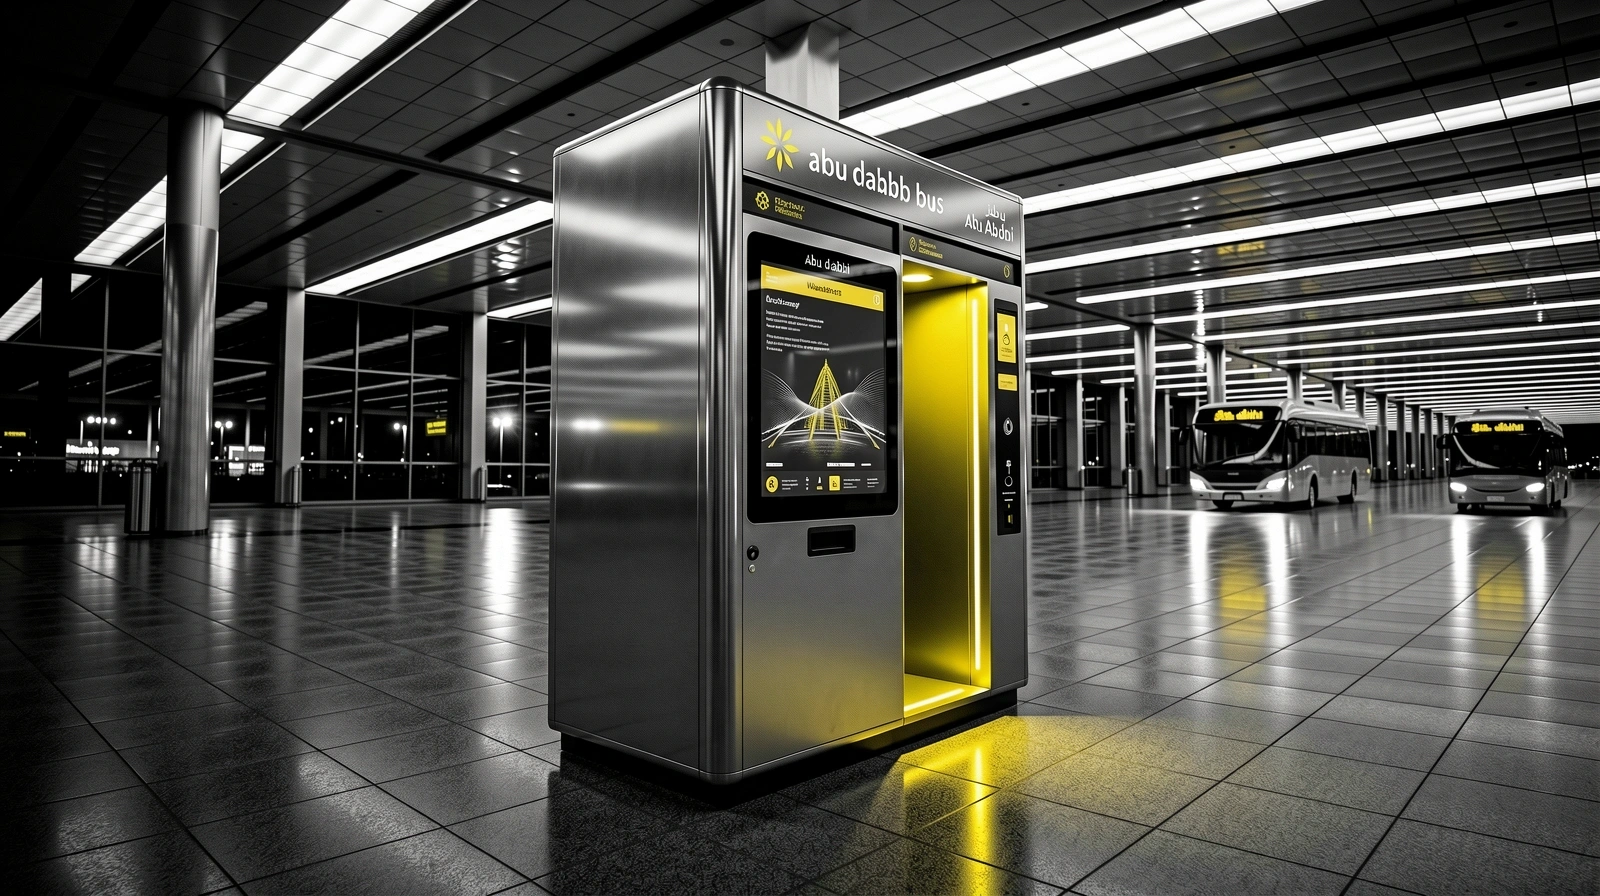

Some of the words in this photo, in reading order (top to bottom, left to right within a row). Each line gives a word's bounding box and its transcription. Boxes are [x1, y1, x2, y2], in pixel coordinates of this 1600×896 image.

[808, 147, 847, 182] abu
[916, 182, 944, 215] bus
[804, 253, 822, 269] Abu
